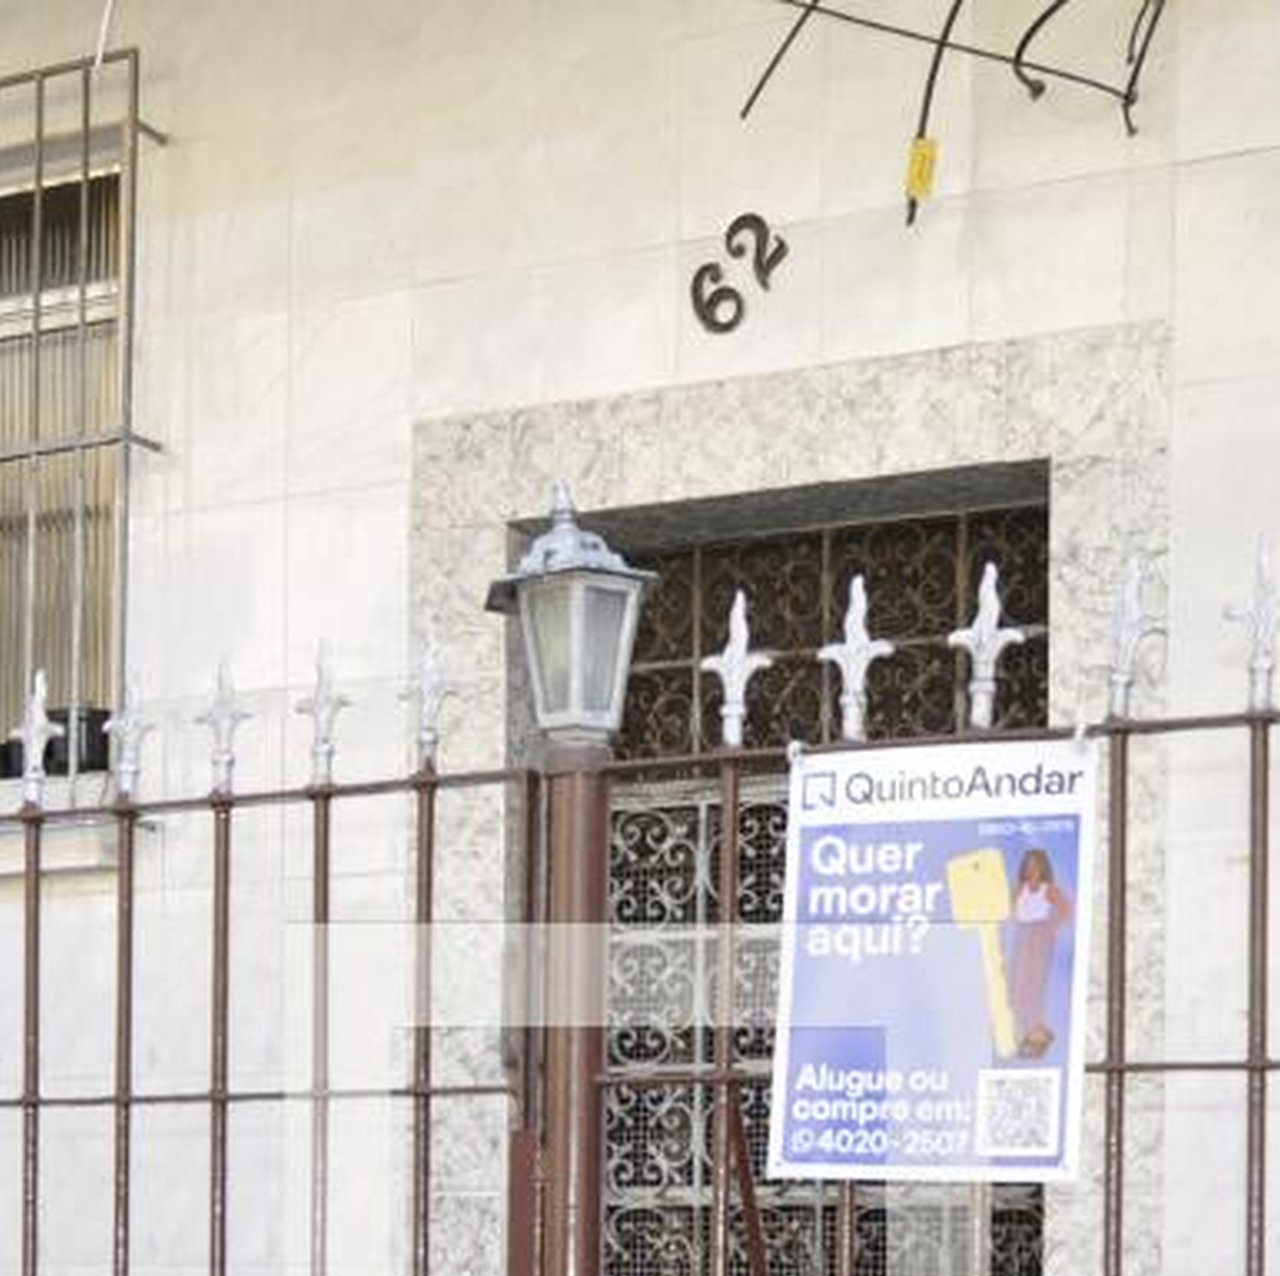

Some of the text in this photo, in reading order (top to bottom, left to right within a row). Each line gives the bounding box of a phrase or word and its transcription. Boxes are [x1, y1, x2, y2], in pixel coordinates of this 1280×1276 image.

[690, 212, 789, 335] 62
[845, 766, 1084, 804] QuintoAndar
[812, 835, 924, 876] Quer
[809, 882, 943, 915] morar
[807, 915, 930, 965] aqui?
[795, 1063, 949, 1097] Alugue ou
[792, 1098, 910, 1126] compre
